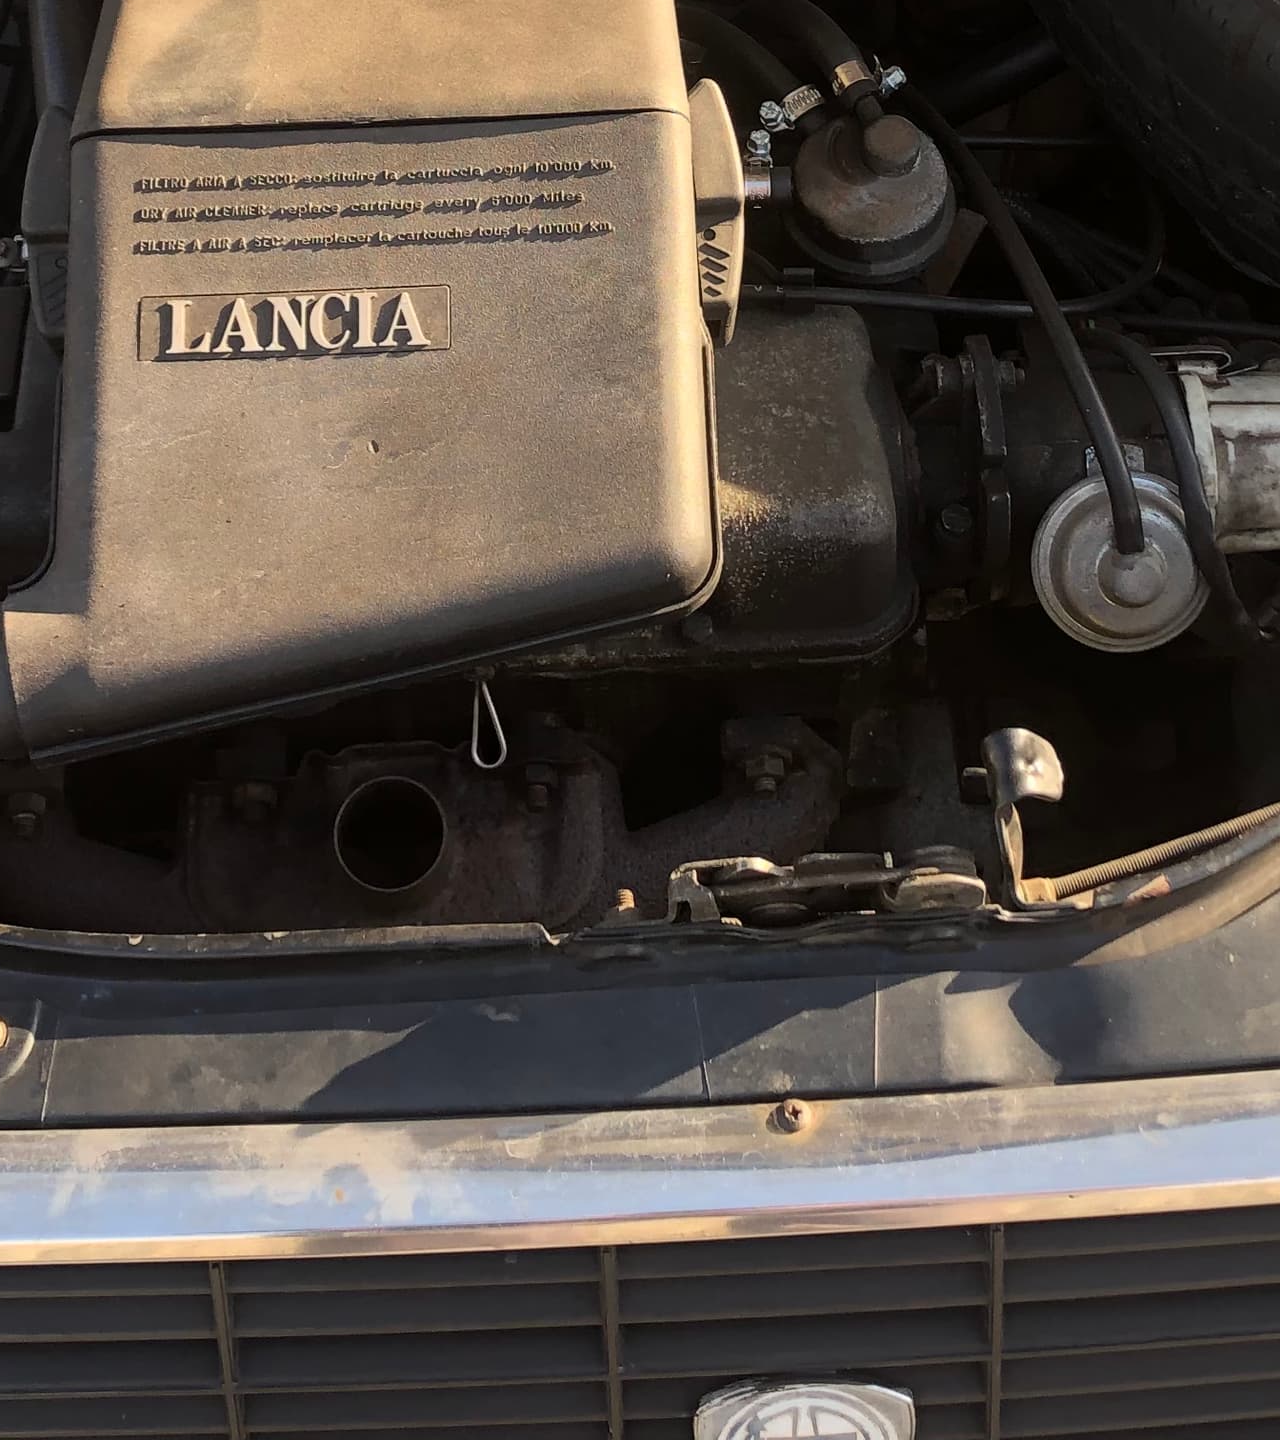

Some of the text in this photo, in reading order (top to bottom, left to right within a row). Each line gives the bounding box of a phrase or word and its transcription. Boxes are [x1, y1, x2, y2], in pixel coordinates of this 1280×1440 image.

[141, 177, 188, 190] FILTRO
[196, 175, 227, 188] ARIA
[303, 170, 376, 183] sostituire
[383, 168, 399, 181] la
[406, 164, 484, 180] cartuccia
[494, 162, 528, 177] ogni
[141, 207, 169, 220] DRY
[175, 206, 198, 219] AIR
[279, 201, 341, 217] replace
[351, 196, 424, 212] cartridge
[434, 196, 482, 211] every
[139, 239, 187, 252] FILTRE
[208, 237, 232, 250] AIR
[294, 233, 373, 248] remplacer
[378, 229, 393, 243] la
[397, 226, 472, 241] cartouche
[478, 224, 510, 238] tous
[164, 289, 431, 356] LANCIA
